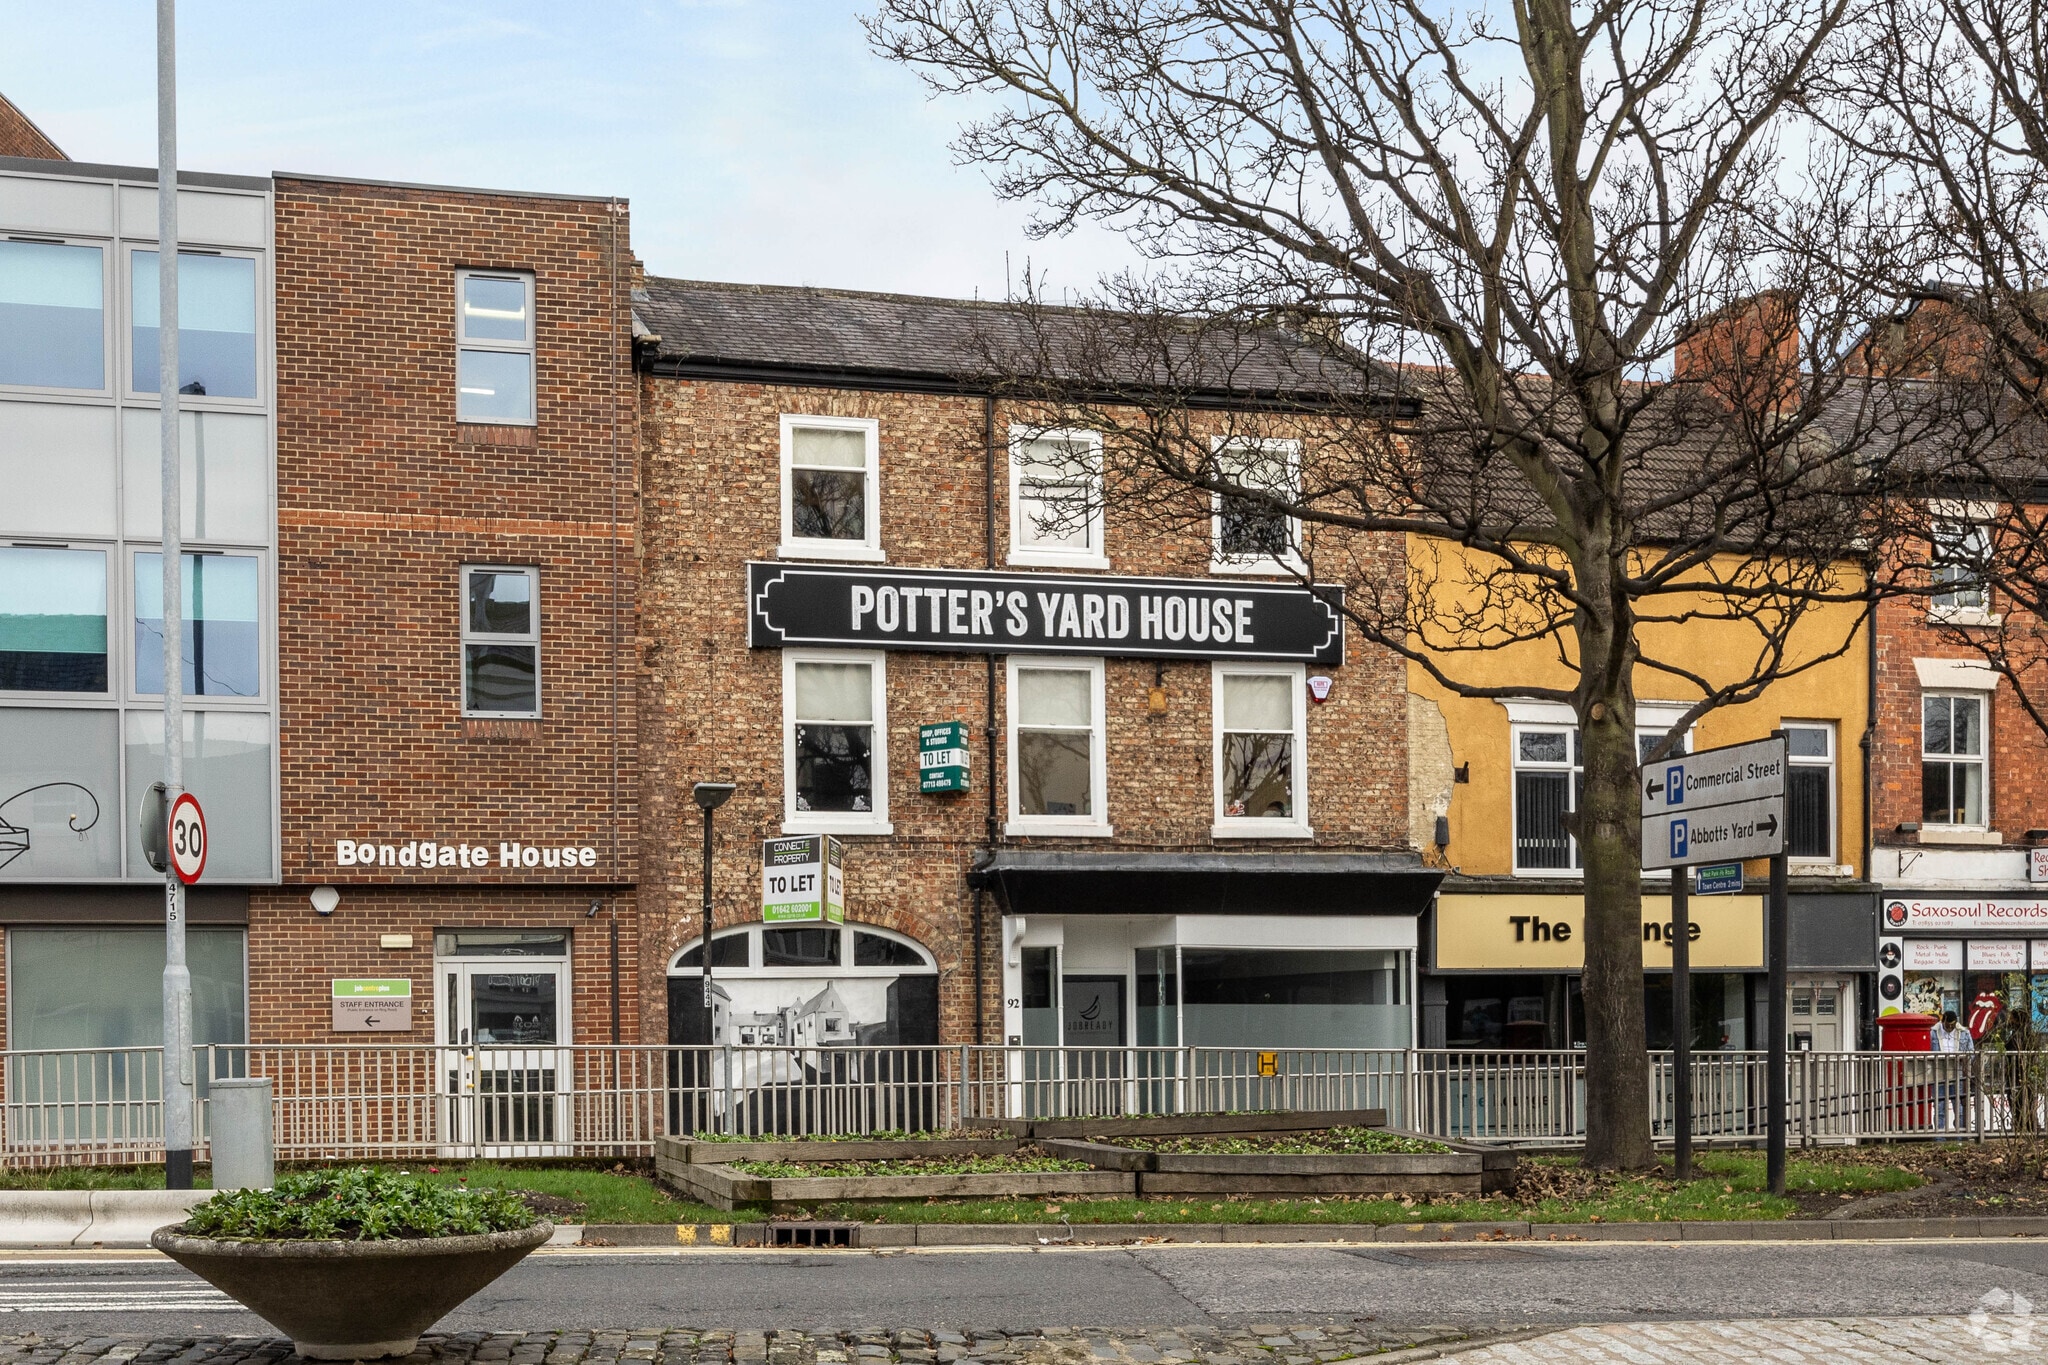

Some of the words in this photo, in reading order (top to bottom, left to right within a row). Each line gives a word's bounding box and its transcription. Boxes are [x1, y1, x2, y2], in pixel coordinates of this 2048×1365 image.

[851, 585, 1028, 637] POTTER'S
[1038, 592, 1129, 639] YARD
[1140, 595, 1254, 644] HOUSE
[923, 752, 934, 766] TO
[937, 751, 951, 765] LET
[1686, 765, 1743, 791] Commercial
[1747, 759, 1781, 780] Street
[174, 819, 202, 858] 30
[1690, 825, 1728, 845] Abbotts
[1731, 820, 1754, 839] Yard
[336, 839, 489, 869] Bondgate
[499, 842, 597, 868] House
[774, 841, 805, 852] CONNECT
[773, 852, 810, 864] PROPERTY
[769, 876, 786, 894] TO
[791, 874, 815, 892] LET
[1702, 882, 1712, 890] Town
[1712, 881, 1727, 890] Centre
[168, 883, 177, 921] 4715
[1911, 903, 1982, 917] Saxosoul
[1986, 903, 2047, 917] Records
[1509, 916, 1571, 942] The
[1007, 998, 1020, 1009] 92
